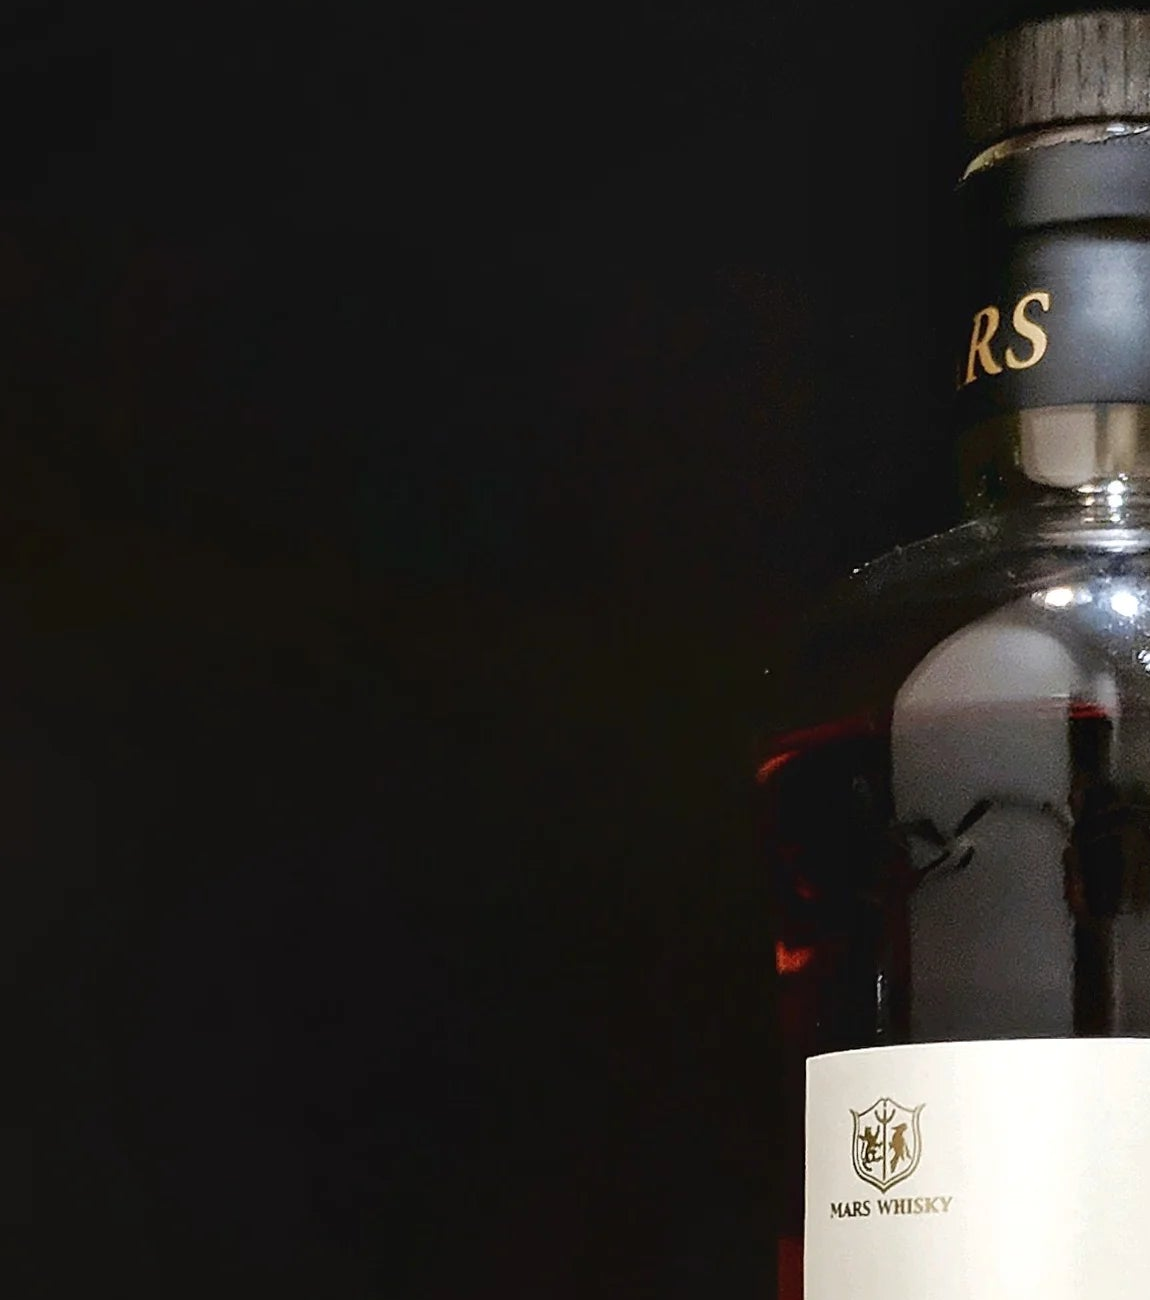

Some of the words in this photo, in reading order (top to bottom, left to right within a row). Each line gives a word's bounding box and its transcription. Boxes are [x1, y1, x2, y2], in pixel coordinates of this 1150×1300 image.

[957, 291, 1050, 390] RS
[830, 1200, 871, 1218] MARS
[877, 1196, 953, 1215] WHISKY
